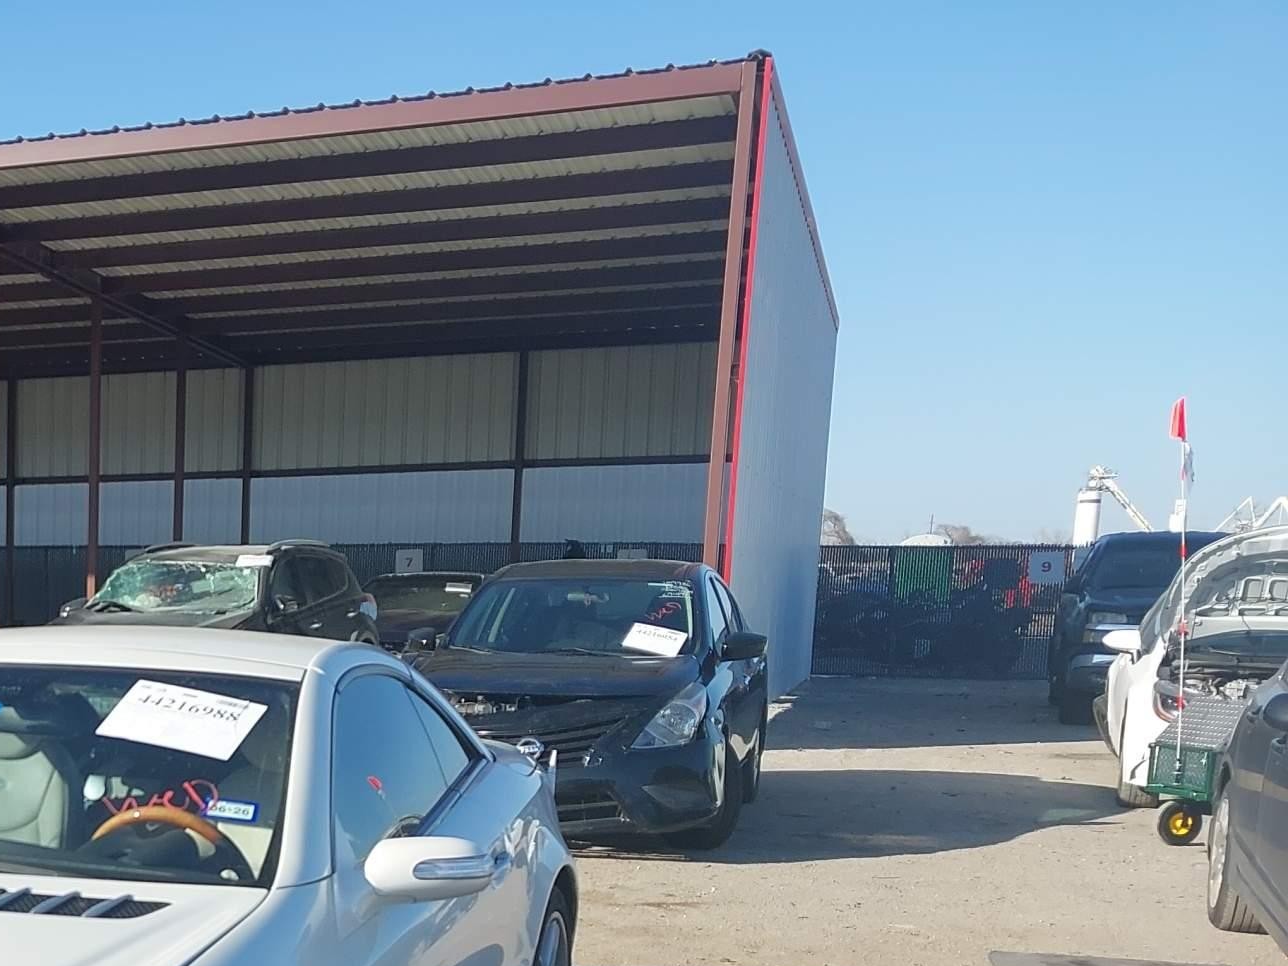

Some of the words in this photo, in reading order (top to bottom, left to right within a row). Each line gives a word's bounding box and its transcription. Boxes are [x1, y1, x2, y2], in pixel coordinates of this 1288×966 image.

[404, 557, 414, 568] 7
[1041, 561, 1052, 573] 9
[138, 694, 241, 721] 44216988
